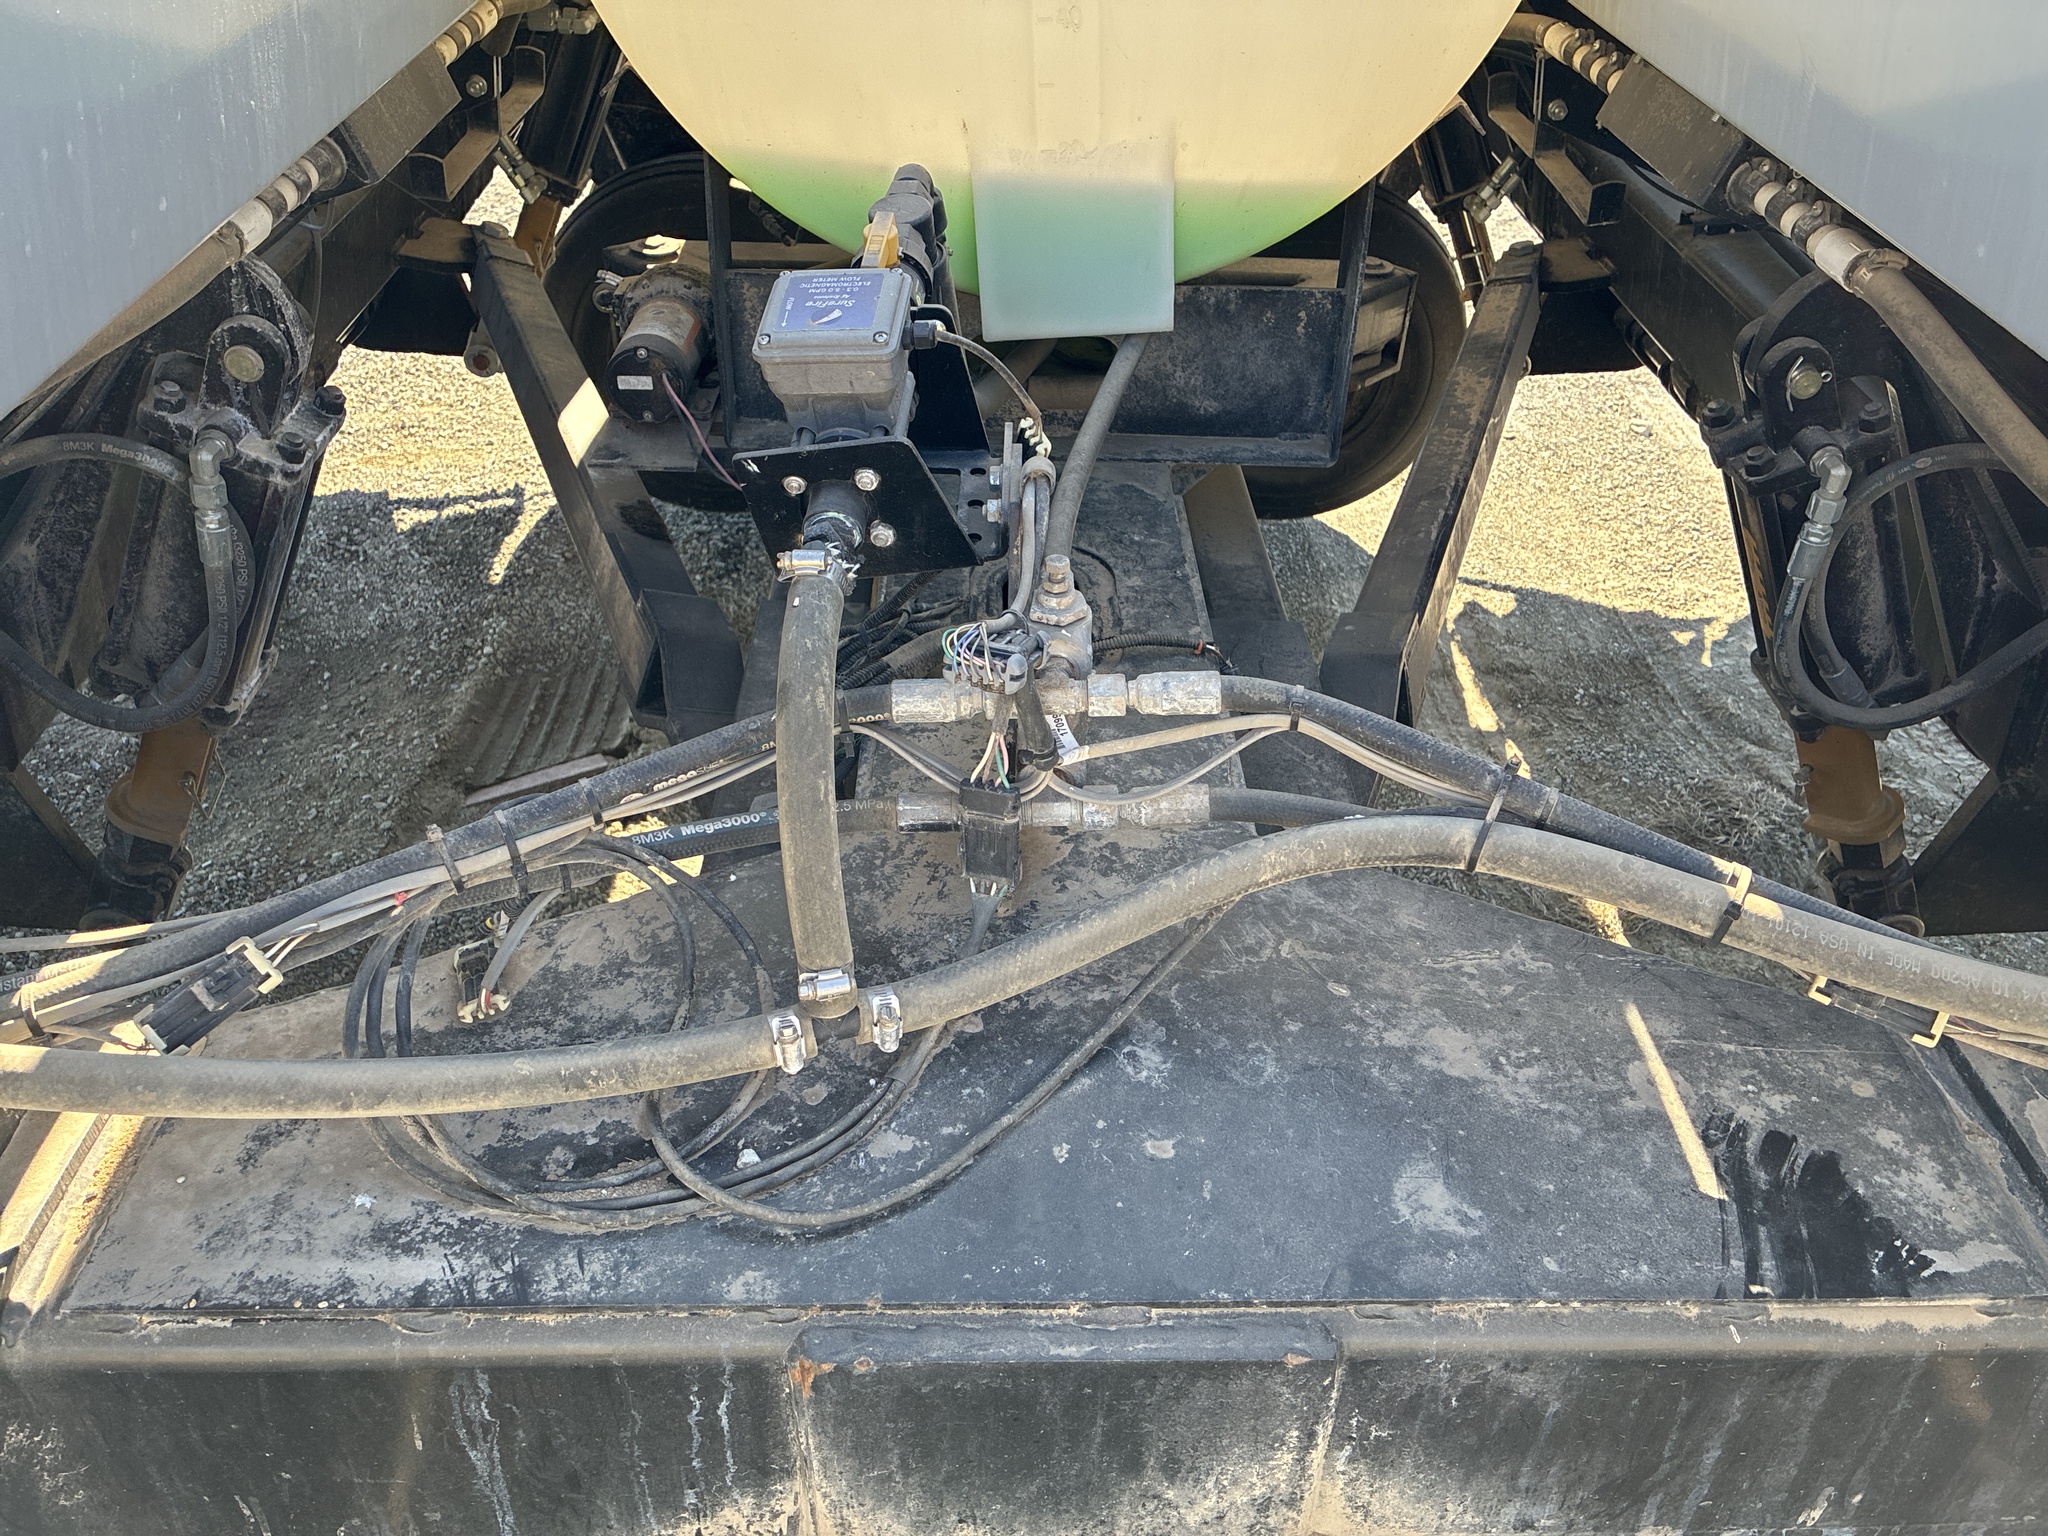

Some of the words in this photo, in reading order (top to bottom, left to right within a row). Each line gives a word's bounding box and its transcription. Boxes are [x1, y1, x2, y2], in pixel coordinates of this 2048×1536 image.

[785, 297, 795, 310] FLOW
[805, 299, 856, 308] SureFire
[62, 441, 95, 451] 8M3K
[631, 828, 675, 846] 8M3K
[1819, 932, 1850, 952] USA
[1857, 943, 1876, 960] IN
[1885, 951, 1921, 974] MADE
